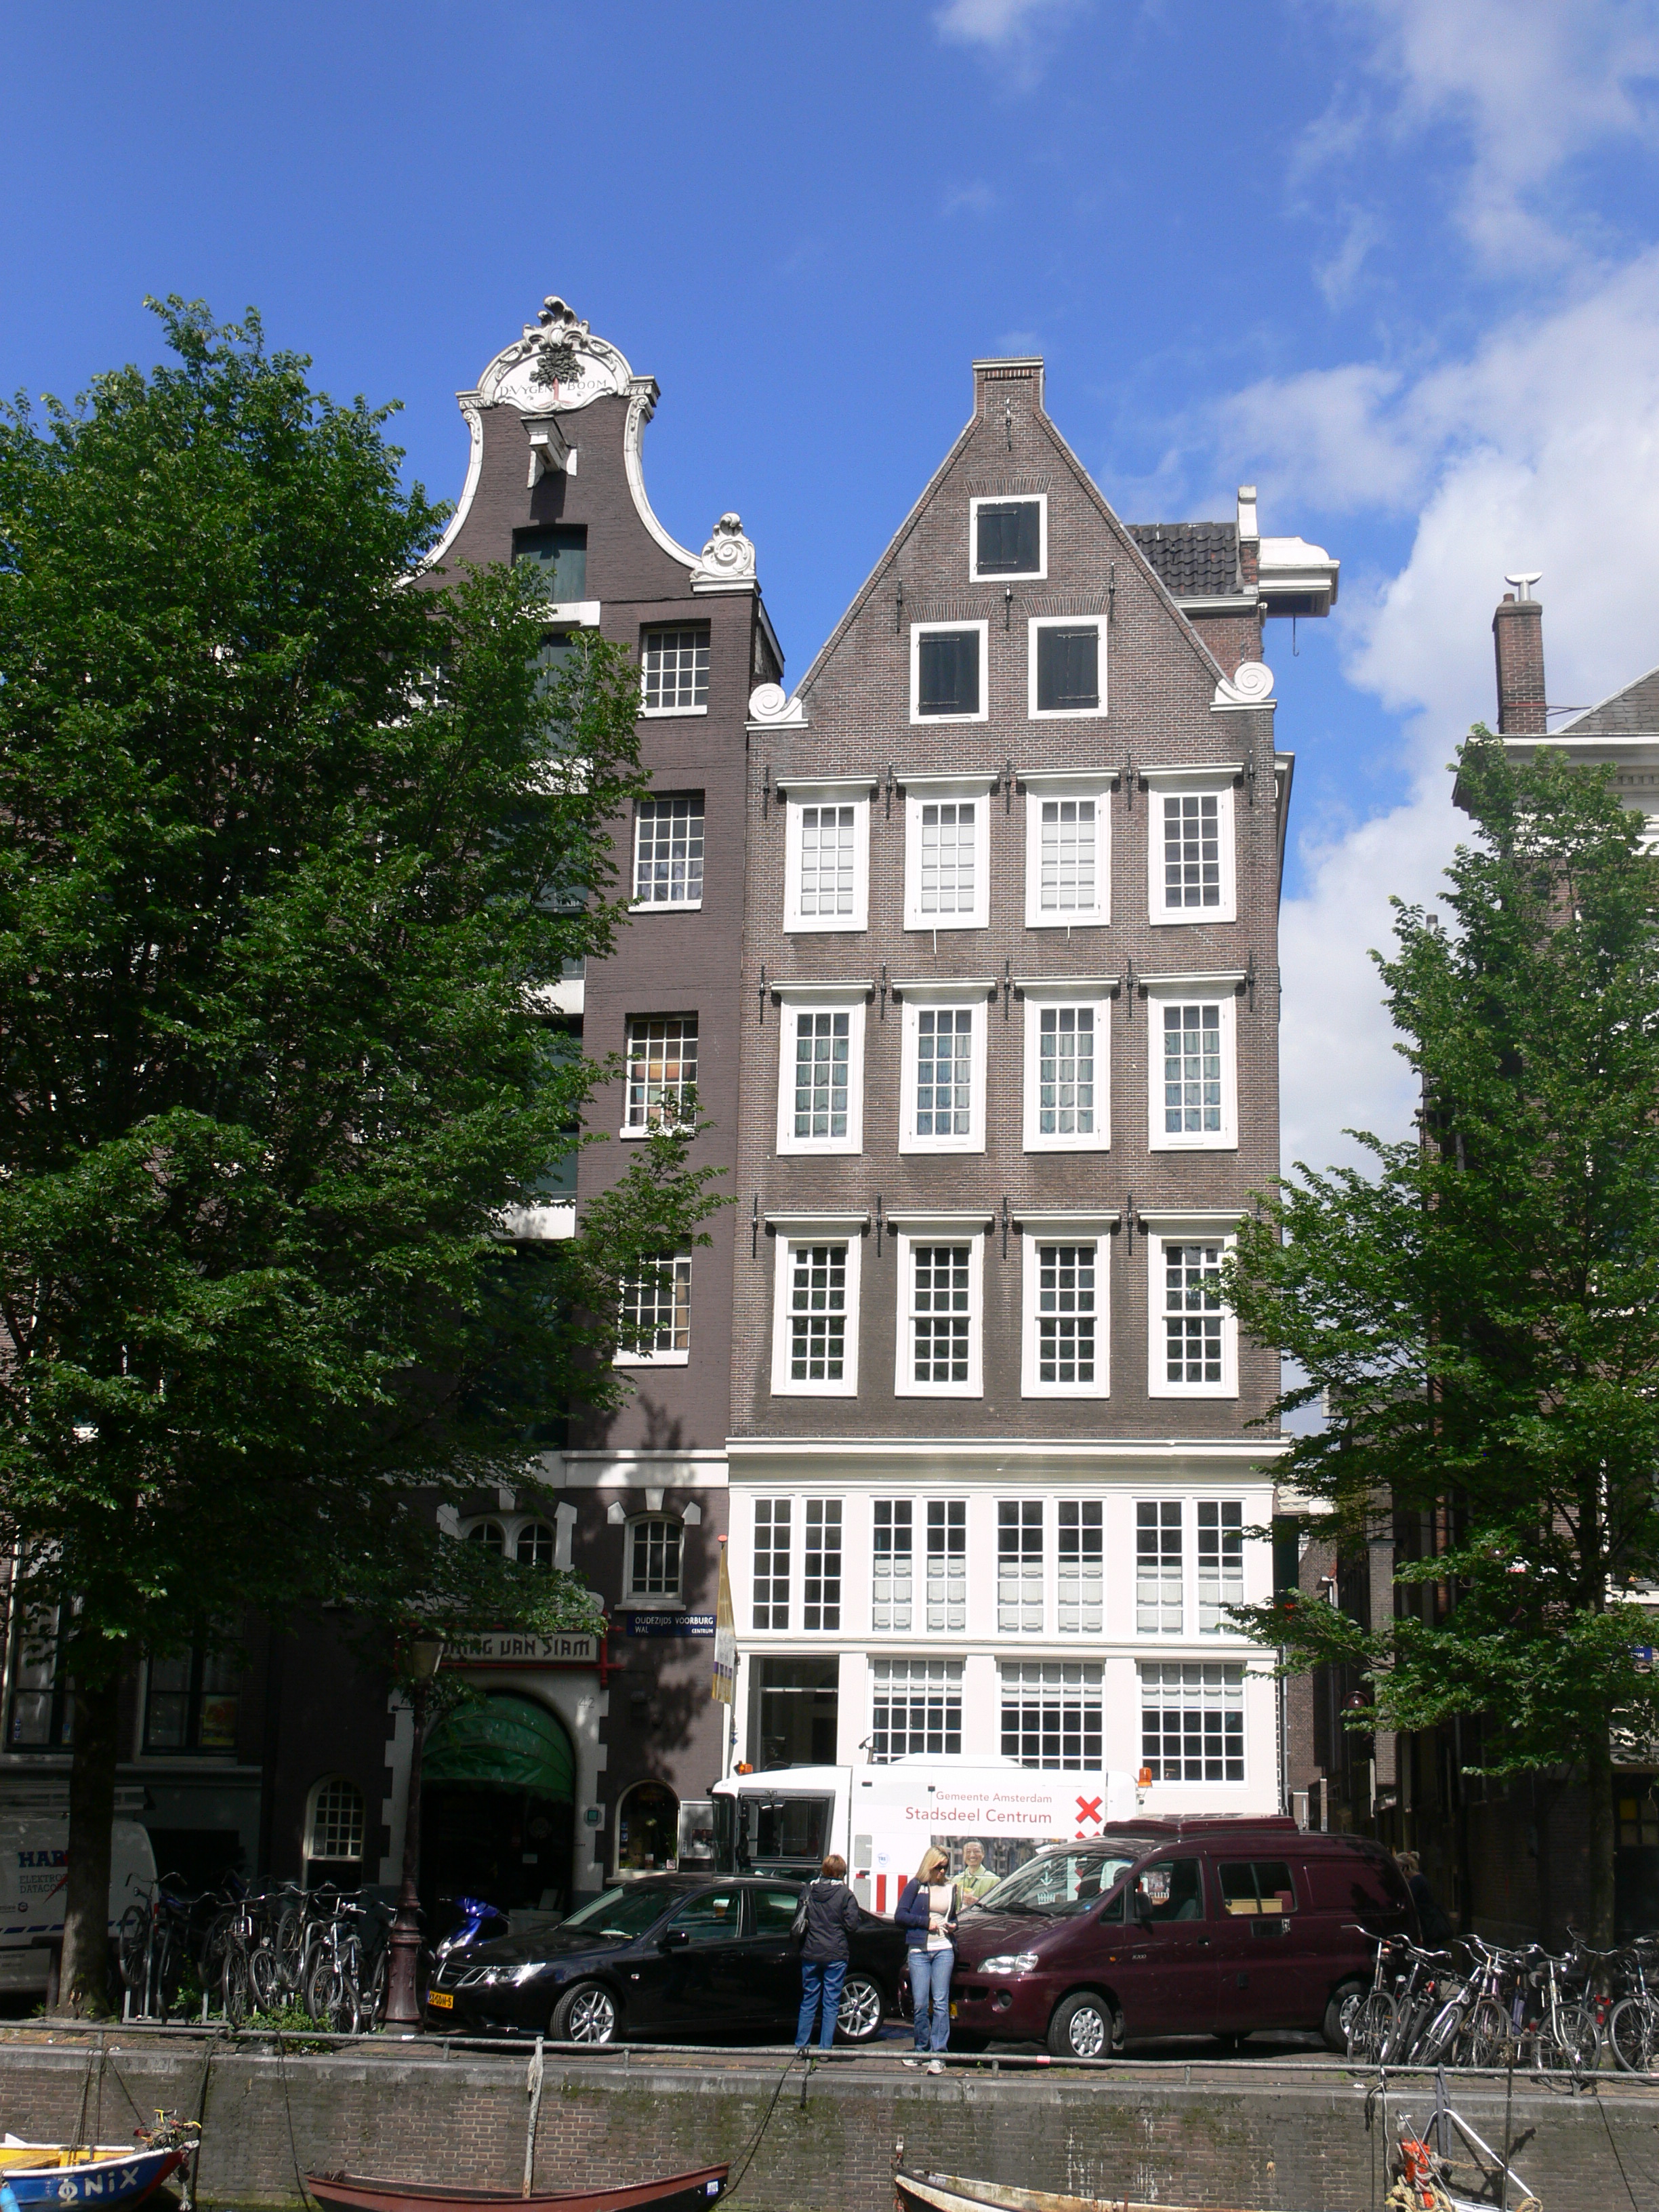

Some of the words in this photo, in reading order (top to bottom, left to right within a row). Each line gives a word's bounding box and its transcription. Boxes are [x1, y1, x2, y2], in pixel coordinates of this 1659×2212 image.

[635, 1616, 672, 1626] OUDEZIJDS
[675, 1616, 714, 1625] VOORBURG
[634, 1626, 649, 1634] WAL
[542, 1635, 590, 1657] SIAM
[579, 1696, 595, 1708] 42
[936, 1790, 989, 1801] Gemeente
[993, 1793, 1052, 1803] Amsterdam
[905, 1807, 980, 1822] Stadsdeel
[986, 1809, 1052, 1823] Centrum
